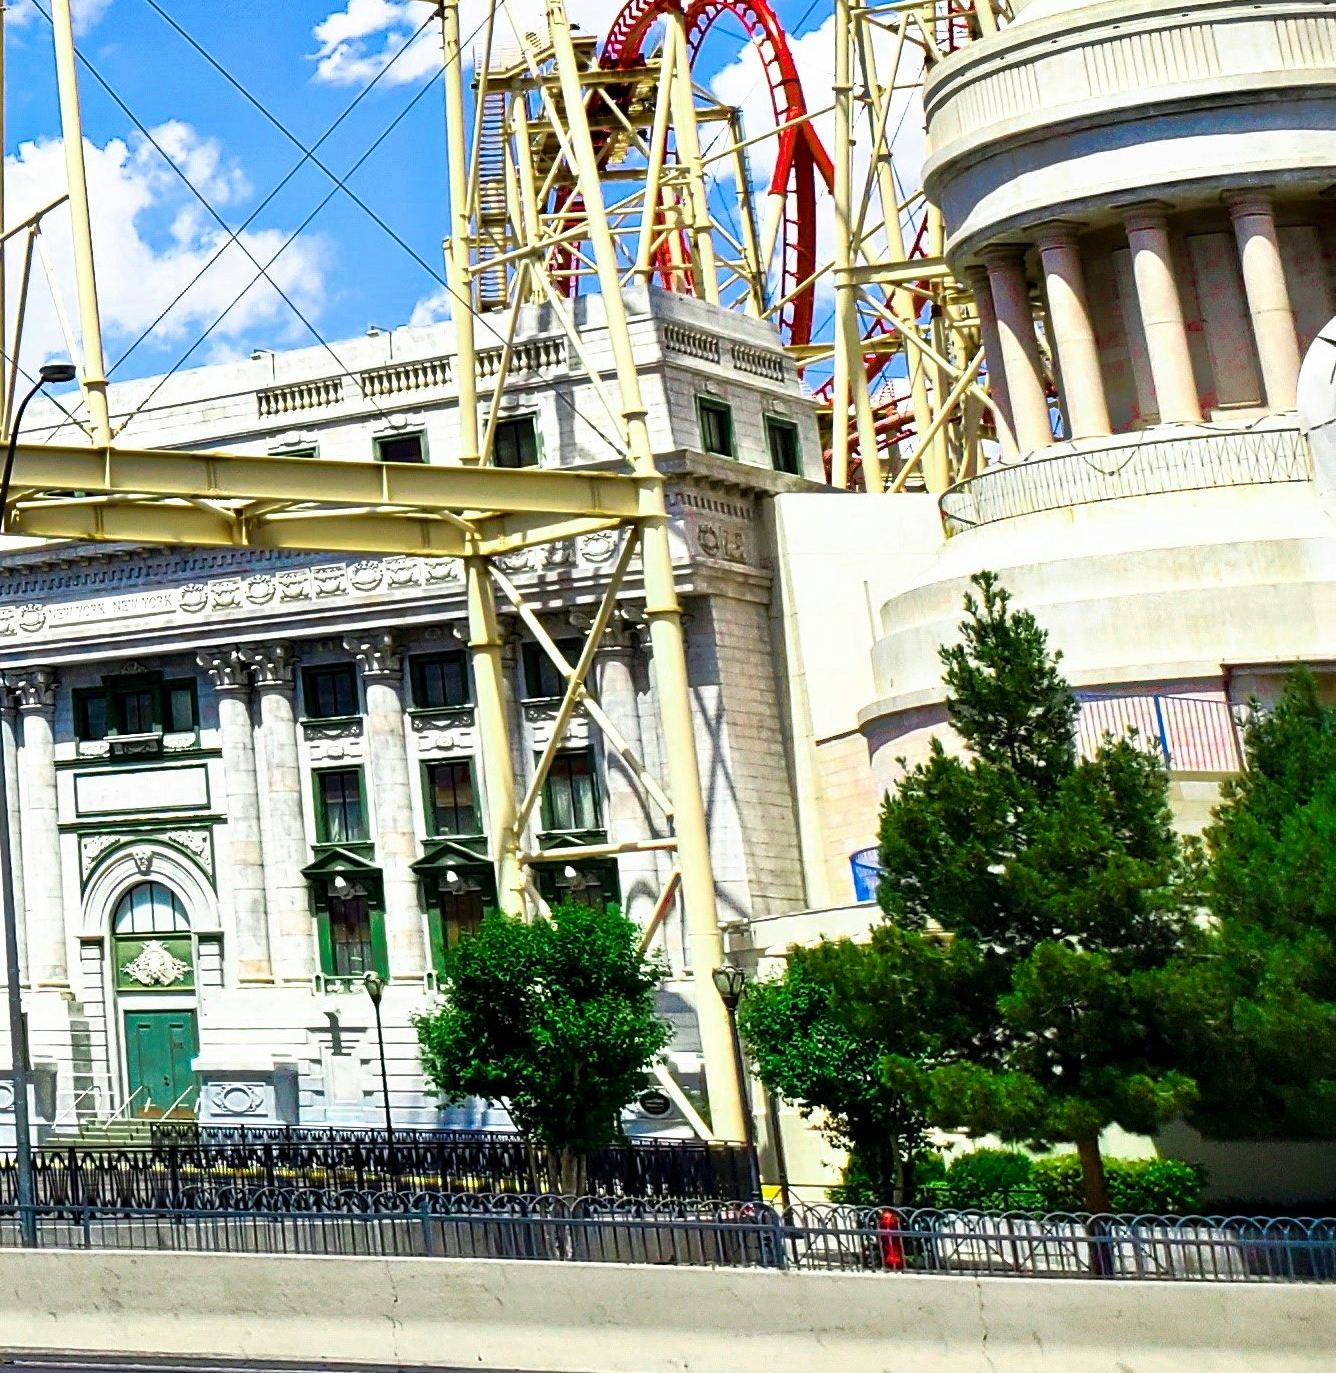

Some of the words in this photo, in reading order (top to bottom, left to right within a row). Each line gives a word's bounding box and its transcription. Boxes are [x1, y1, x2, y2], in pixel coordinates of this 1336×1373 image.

[48, 607, 73, 620] NEW
[75, 602, 105, 617] YORK
[112, 598, 138, 613] NEW
[141, 594, 173, 609] YORK
